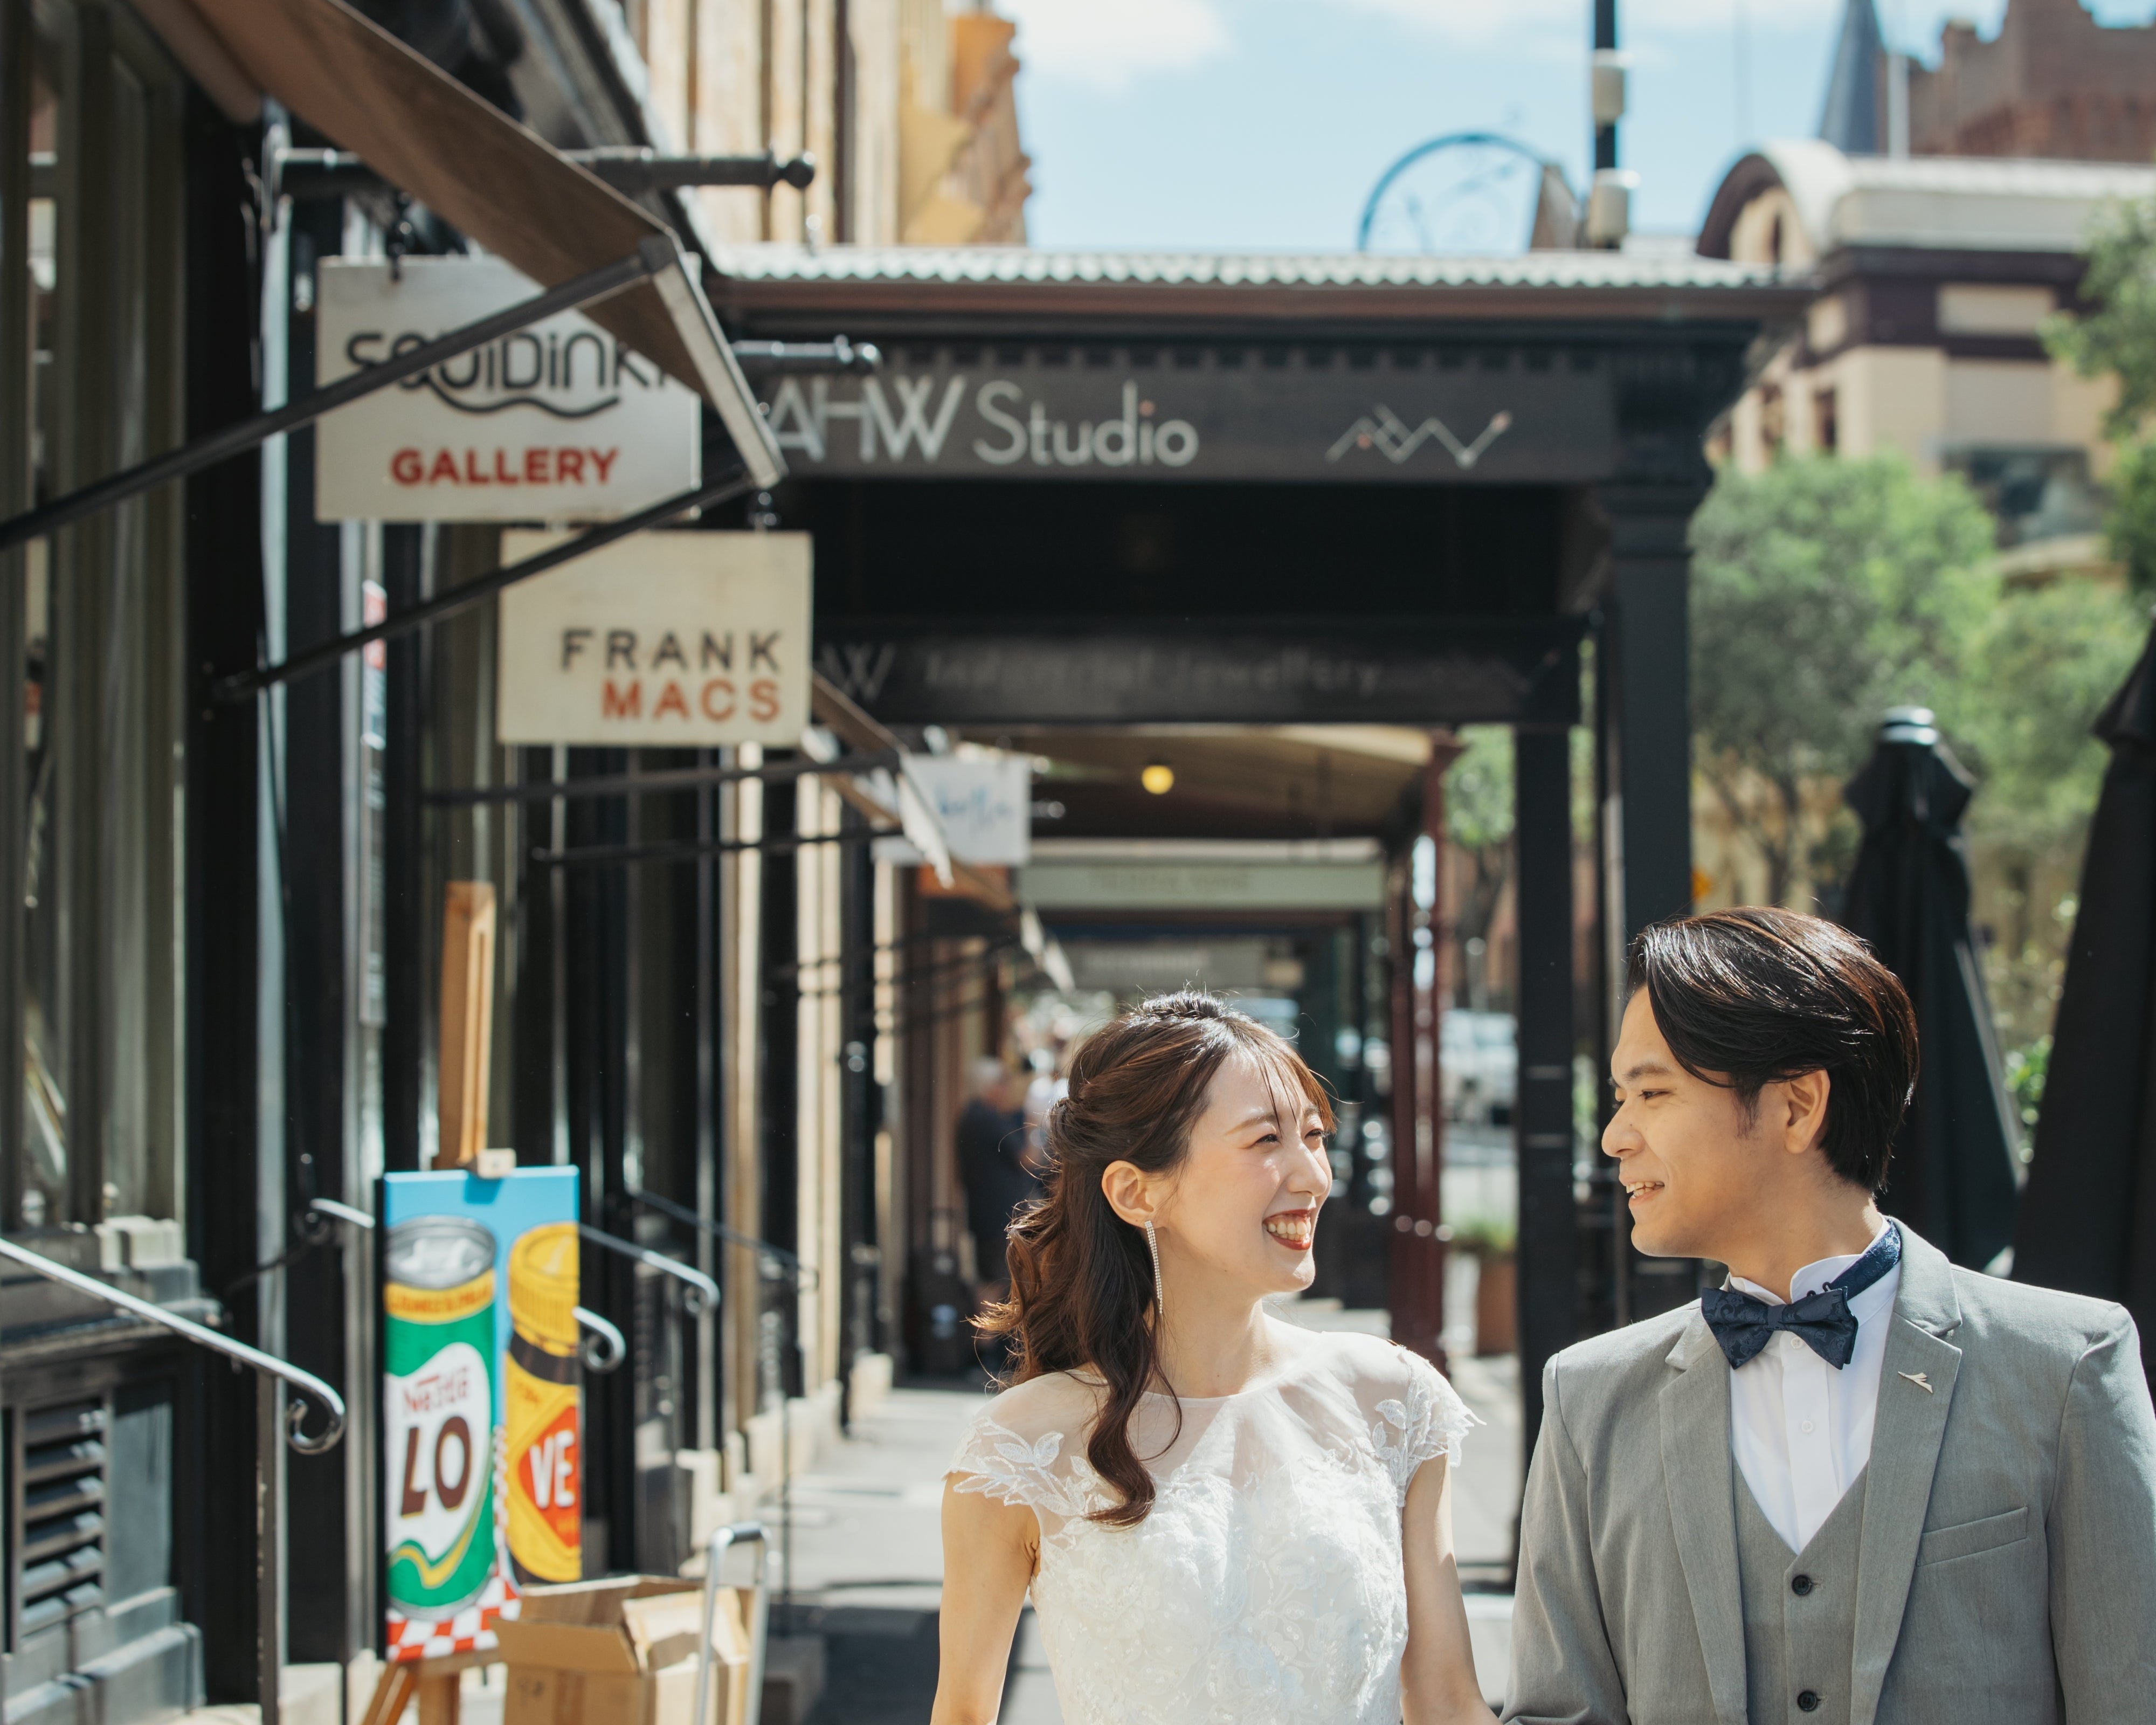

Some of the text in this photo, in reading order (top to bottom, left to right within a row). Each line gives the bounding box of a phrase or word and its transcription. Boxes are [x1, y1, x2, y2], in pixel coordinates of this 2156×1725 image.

[974, 380, 1199, 467] Studio
[392, 448, 619, 485] GALLERY
[562, 629, 782, 672] FRANK
[603, 679, 781, 722] MACS
[401, 1416, 575, 1518] LO VE
